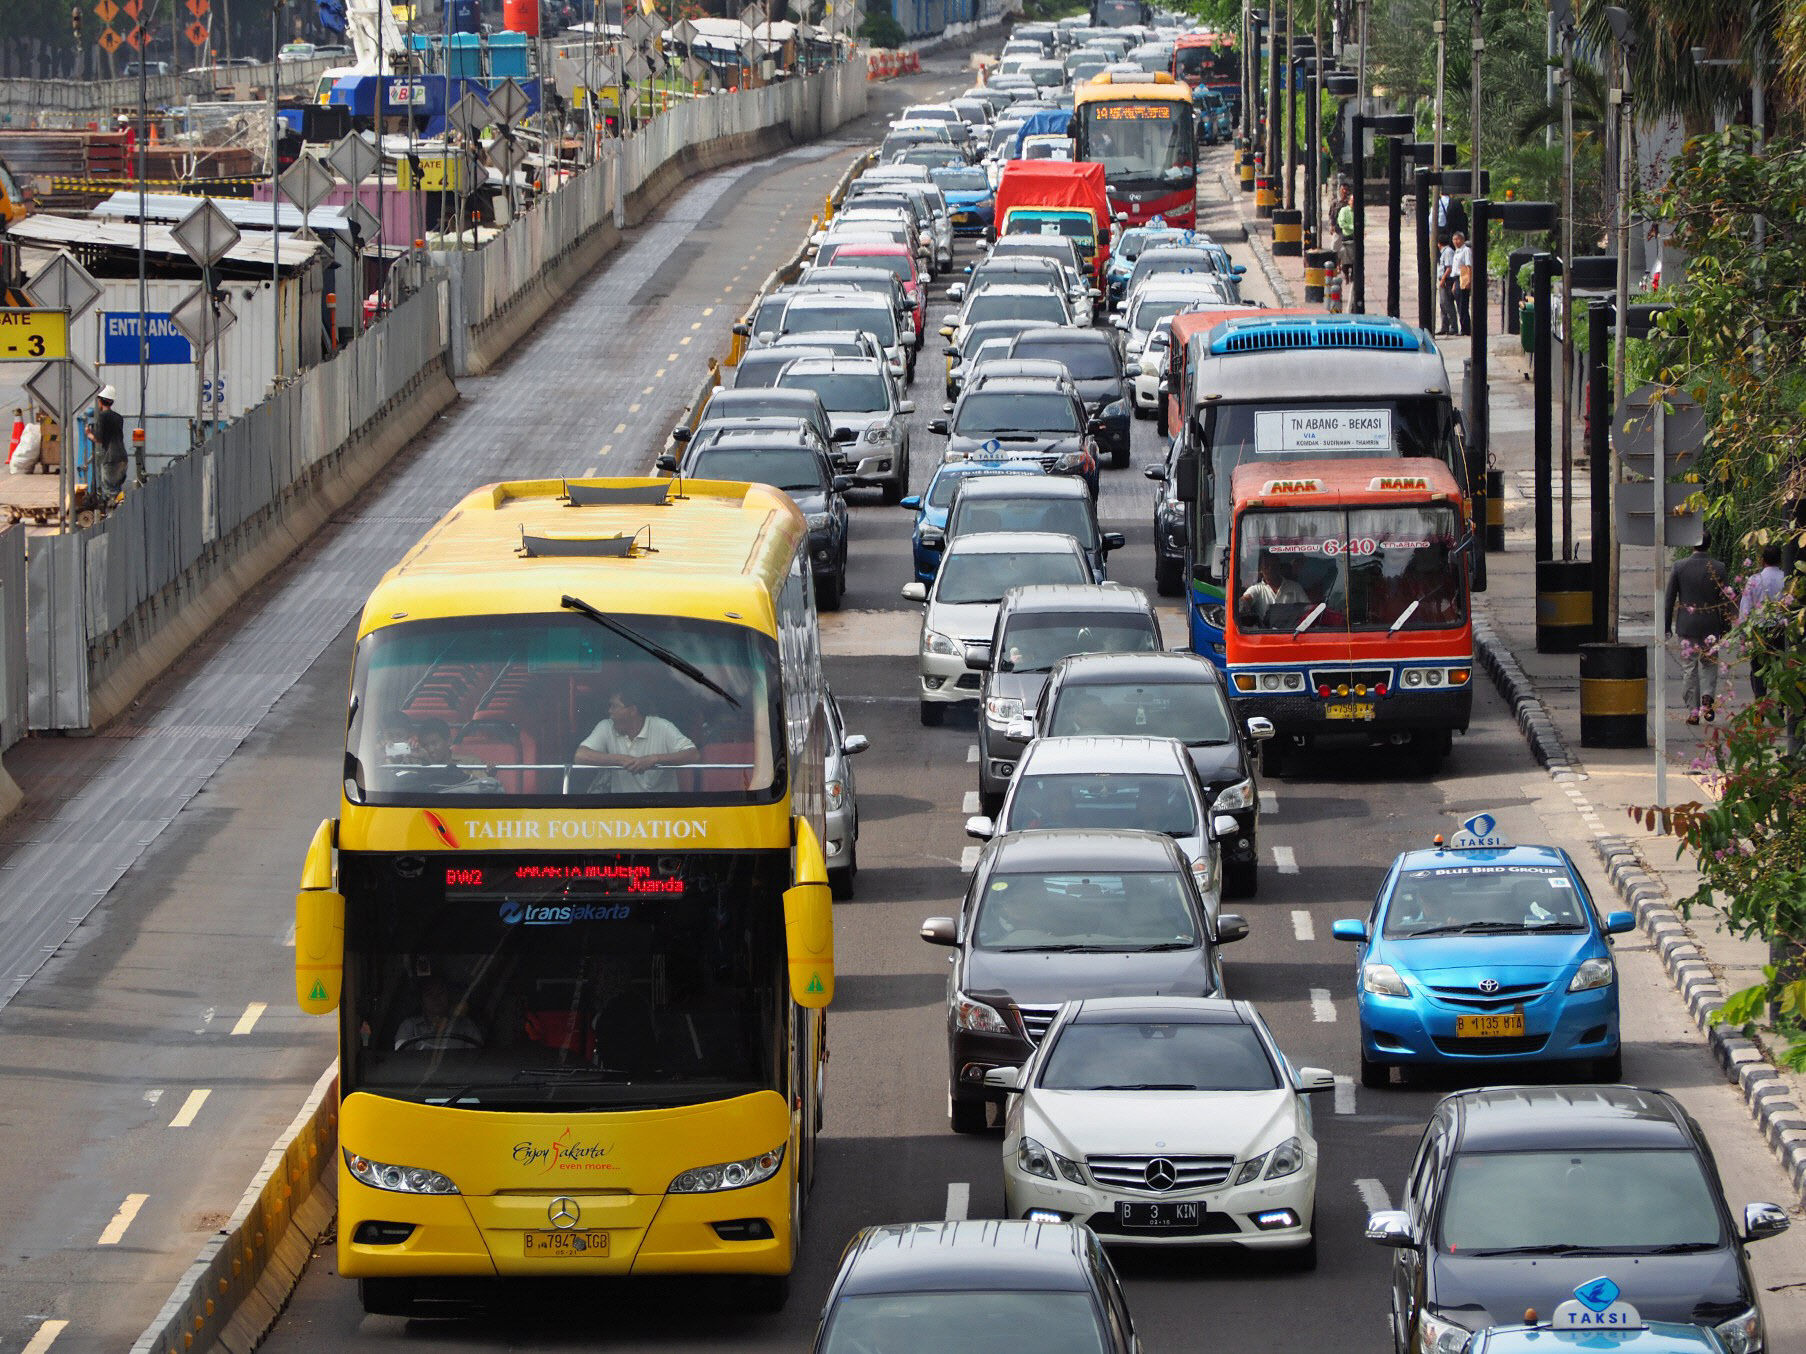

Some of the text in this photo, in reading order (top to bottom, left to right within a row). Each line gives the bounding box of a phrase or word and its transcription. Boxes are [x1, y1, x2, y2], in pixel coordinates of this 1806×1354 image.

[0, 312, 31, 325] ATE
[109, 318, 184, 337] ENTRANC
[28, 335, 45, 356] 3
[1291, 419, 1303, 430] TN
[1305, 418, 1338, 430] ABANG
[1349, 418, 1382, 429] BEKASI
[1271, 480, 1317, 493] ANAK
[1379, 478, 1427, 490] MAMA
[1323, 538, 1376, 556] 640
[464, 820, 708, 838] TAHIR FOUNDATION
[1460, 838, 1500, 846] TAKSI
[628, 877, 684, 892] Juanda
[1458, 1018, 1464, 1029] B
[1474, 1017, 1499, 1029] 1135
[560, 1162, 582, 1170] even
[1124, 1204, 1196, 1218] B 3 KIN
[526, 1235, 533, 1248] B
[547, 1234, 577, 1248] 7947
[586, 1234, 607, 1248] TGB
[1568, 1313, 1627, 1324] TAKSI
